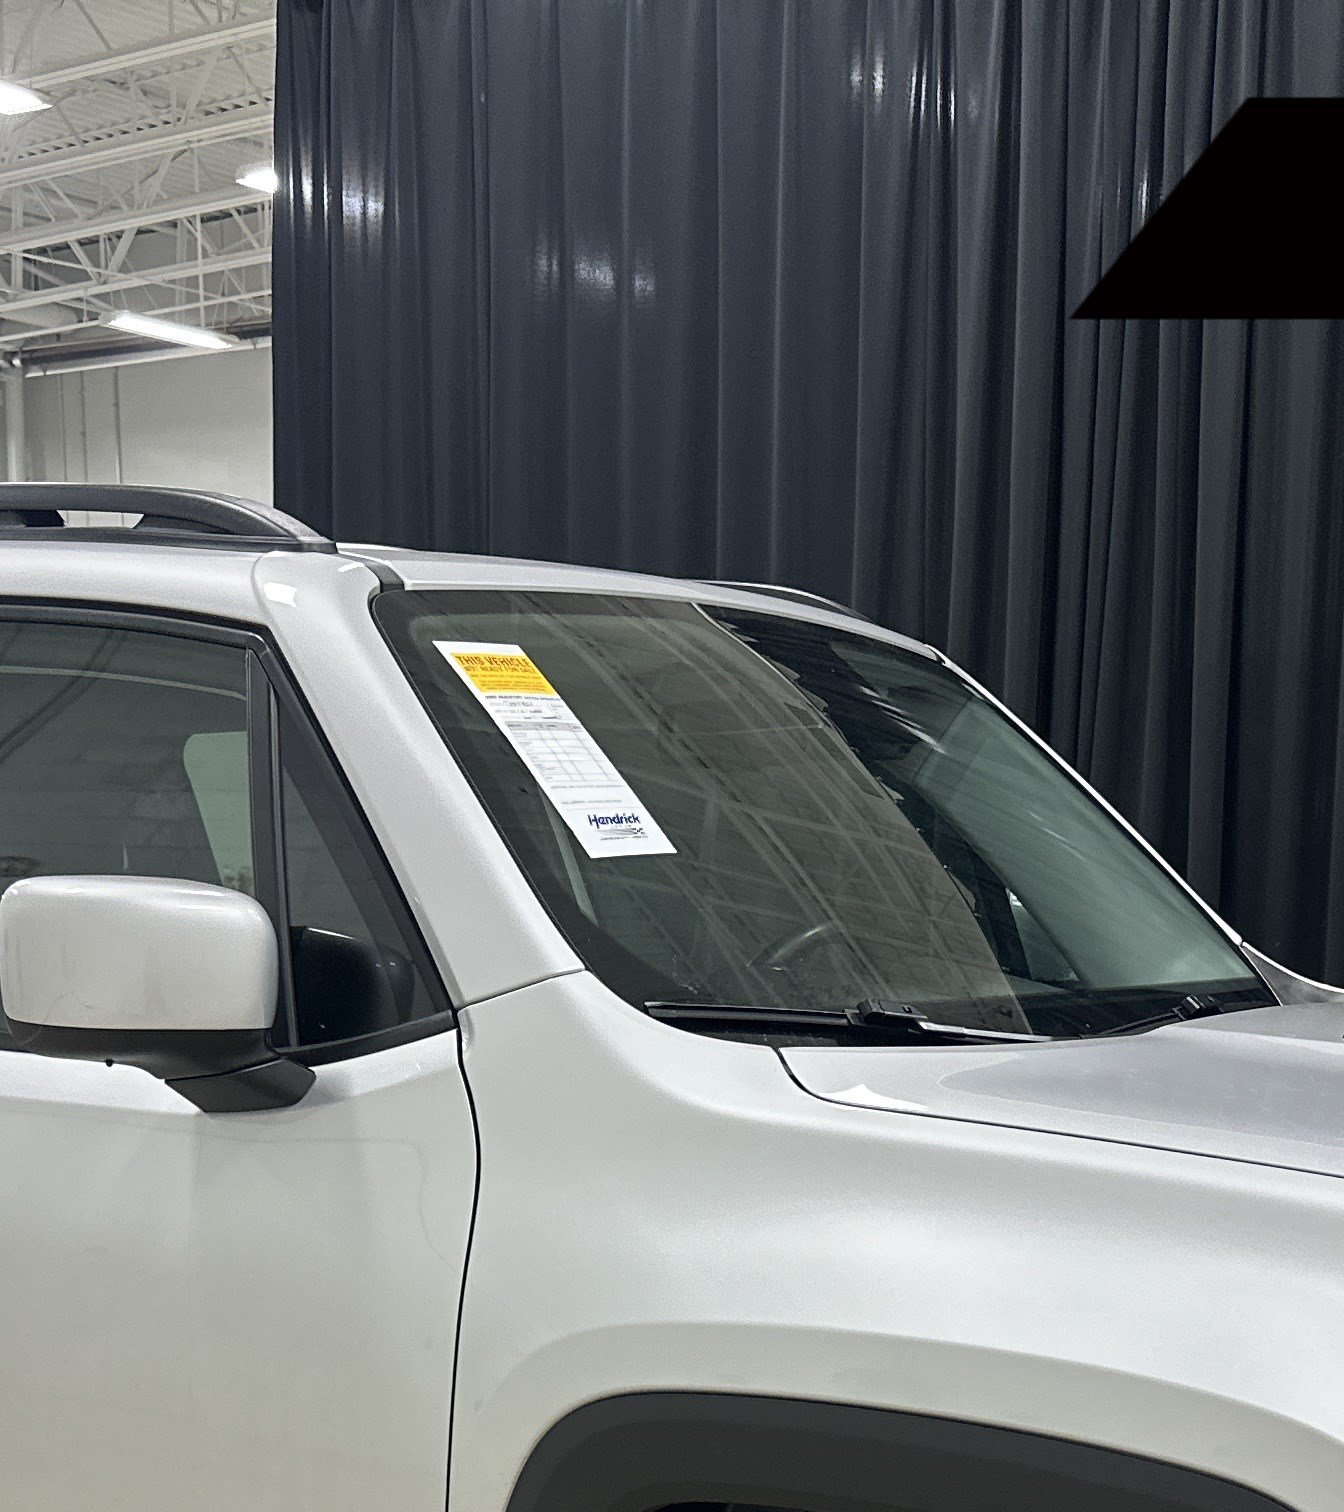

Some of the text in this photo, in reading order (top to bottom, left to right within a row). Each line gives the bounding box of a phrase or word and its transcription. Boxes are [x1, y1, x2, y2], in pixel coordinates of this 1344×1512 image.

[455, 655, 531, 668] THIS VEHICLE
[587, 813, 641, 829] Hendrick
